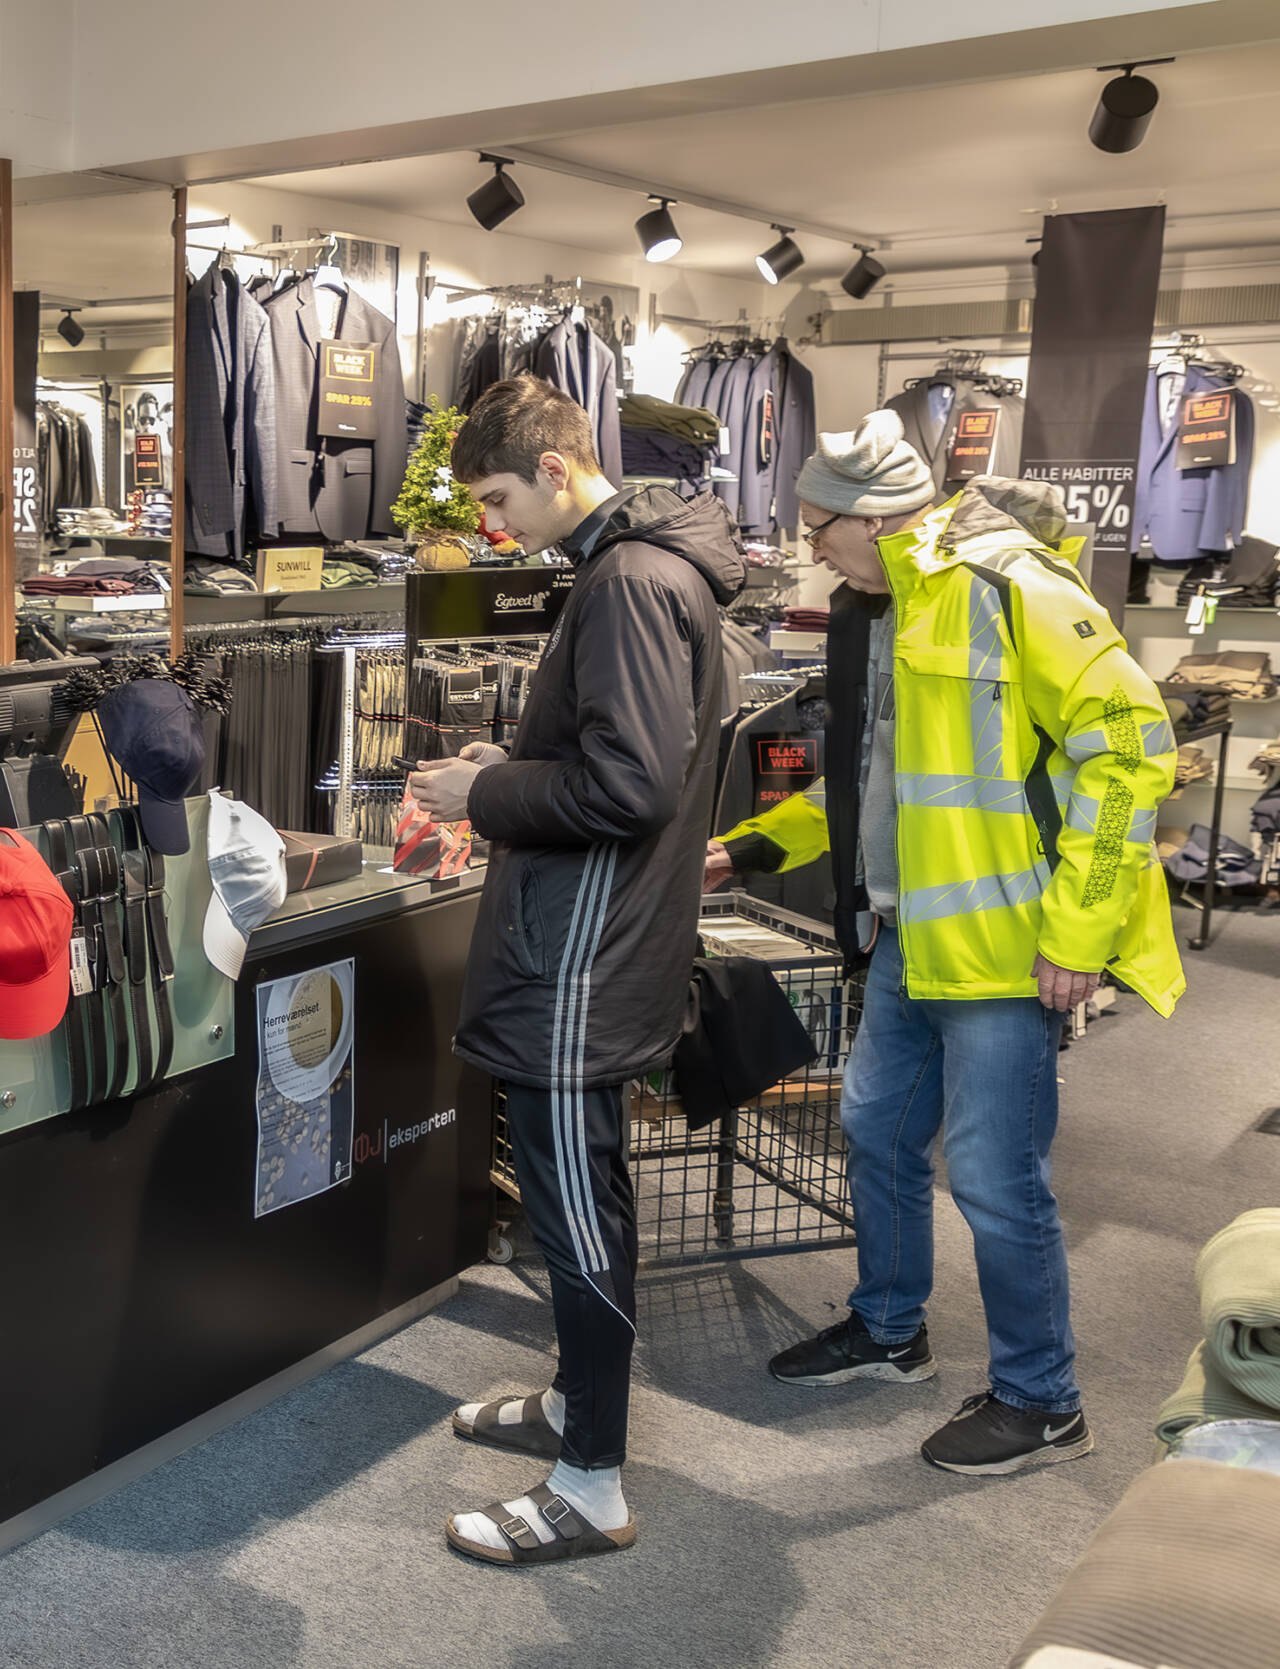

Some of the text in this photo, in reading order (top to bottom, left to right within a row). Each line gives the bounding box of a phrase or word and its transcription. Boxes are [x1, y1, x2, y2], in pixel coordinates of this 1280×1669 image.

[333, 353, 365, 366] BLACK
[1023, 466, 1134, 480] ALLE HABITTER
[276, 561, 312, 572] SUNWILL
[494, 592, 533, 610] Egtved
[767, 747, 806, 758] BLACK
[770, 757, 804, 768] WEEK
[263, 1002, 320, 1029] Herreværelset
[354, 1108, 456, 1165] ØJ eksperten
